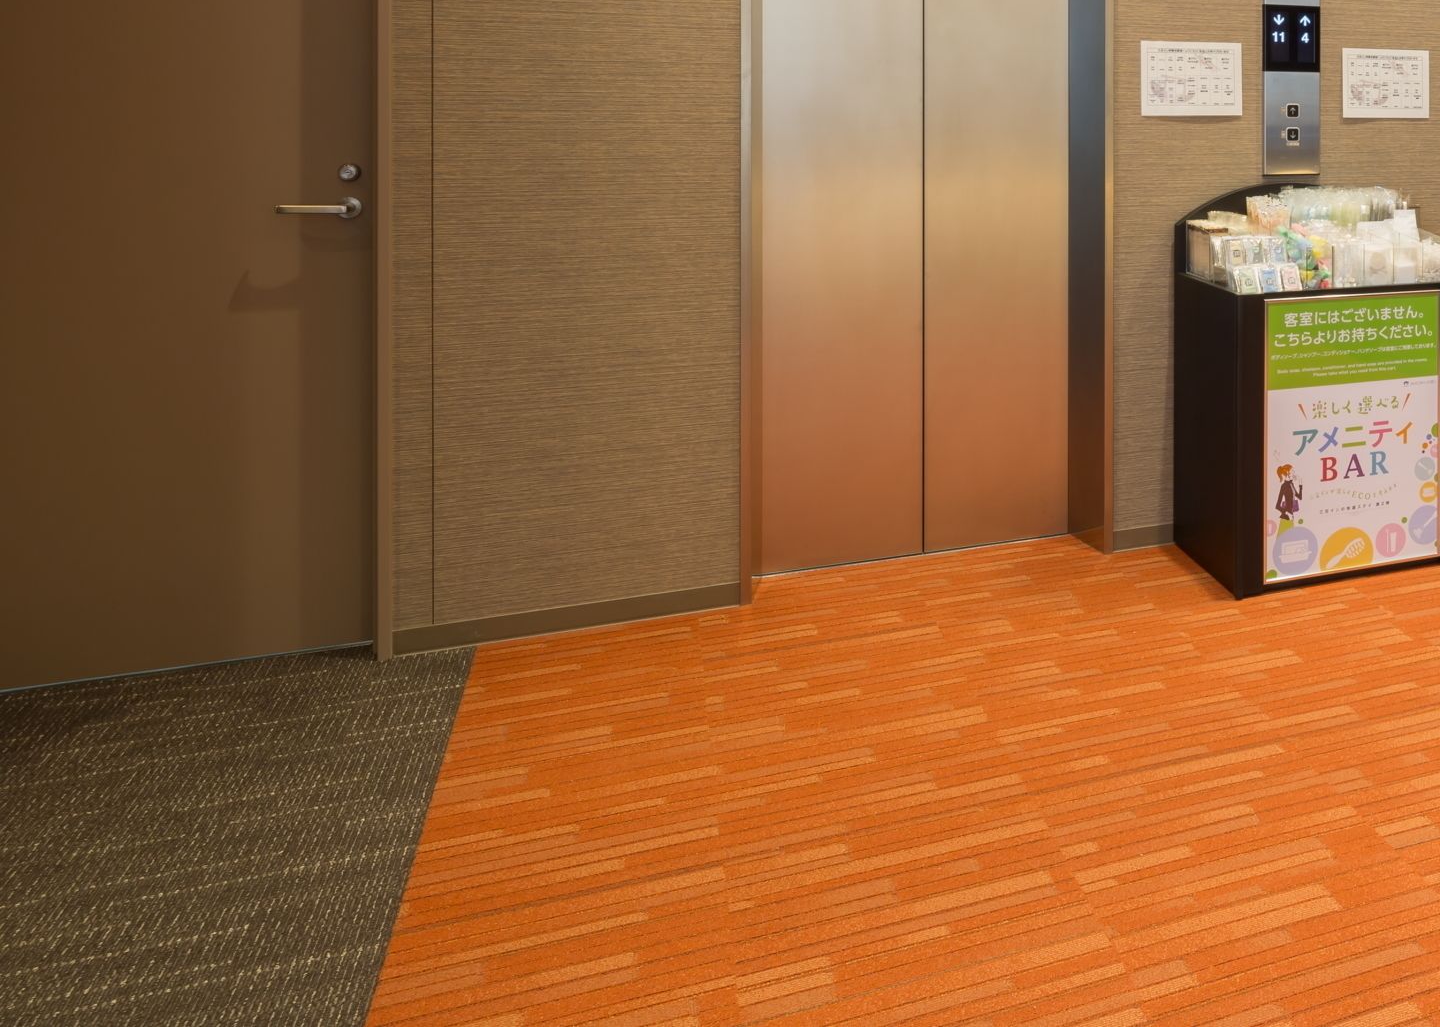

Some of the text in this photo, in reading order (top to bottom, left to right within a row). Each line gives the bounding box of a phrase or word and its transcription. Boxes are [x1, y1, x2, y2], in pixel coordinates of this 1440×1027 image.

[1271, 31, 1286, 43] 11
[1301, 32, 1310, 44] 4
[1284, 305, 1424, 328] 客室にはございません。
[1273, 324, 1433, 348] こちらよりお持ちください。
[1292, 420, 1413, 456] アメニティ
[1320, 451, 1390, 482] BAR
